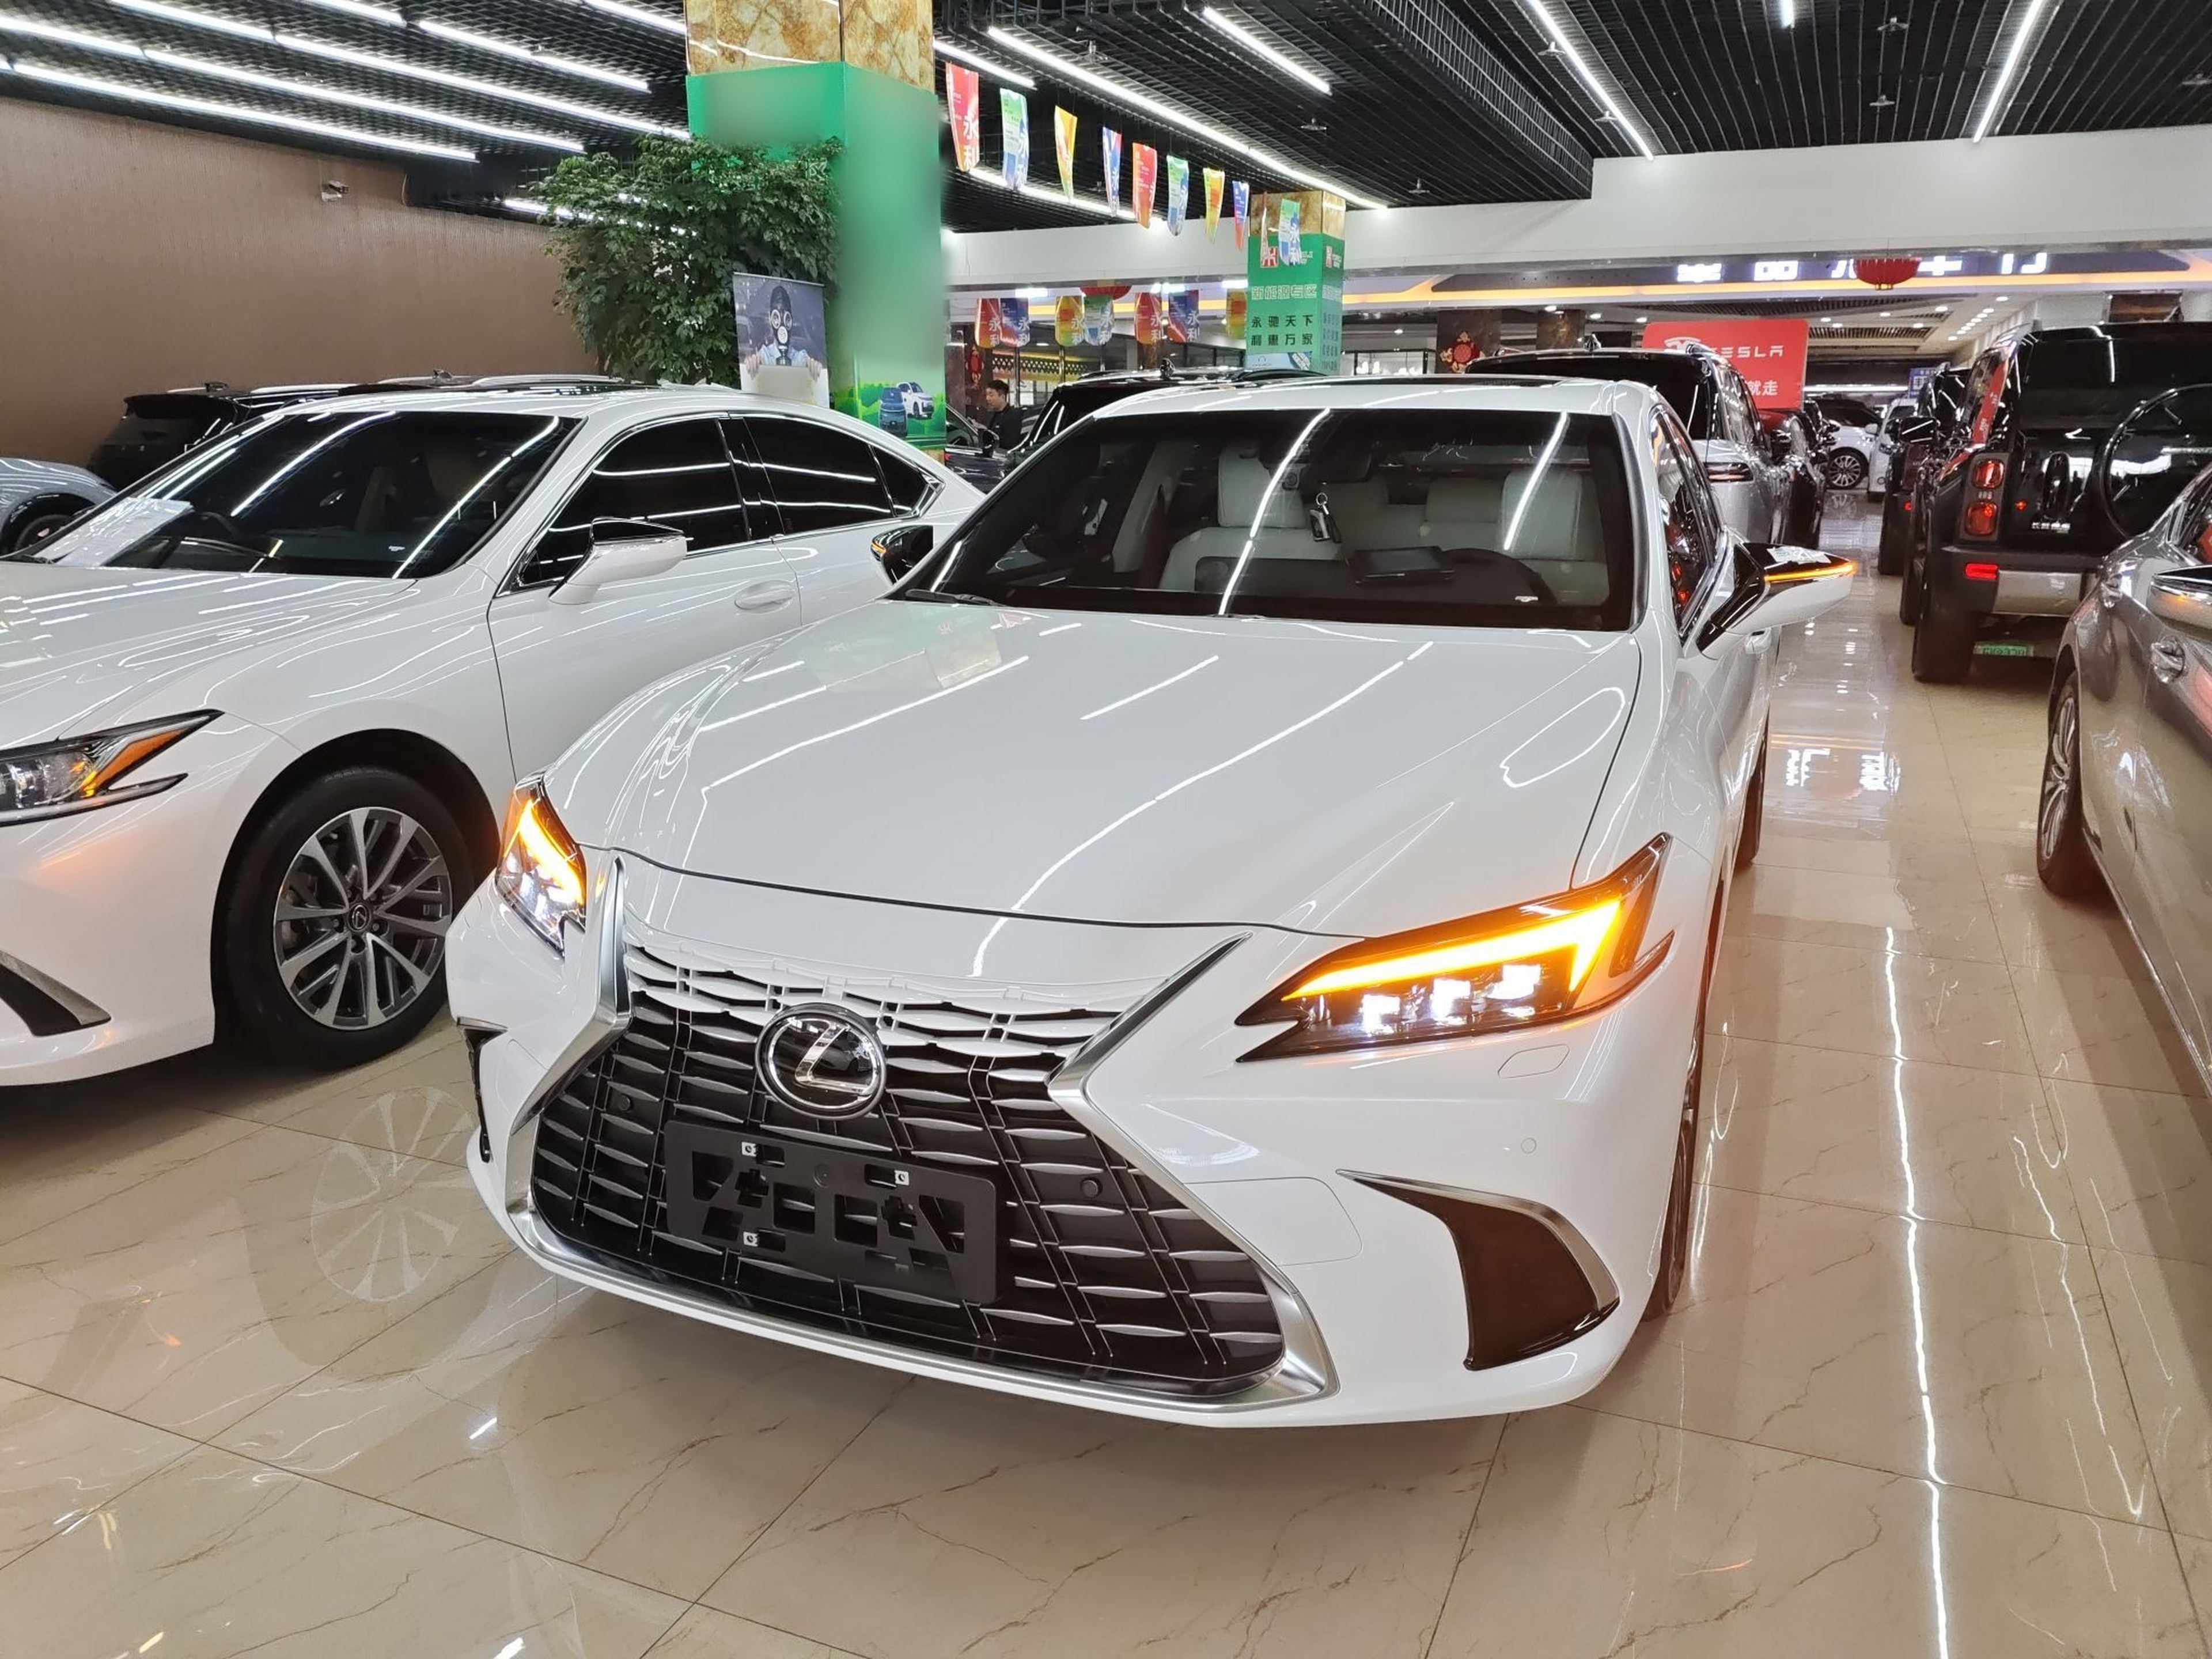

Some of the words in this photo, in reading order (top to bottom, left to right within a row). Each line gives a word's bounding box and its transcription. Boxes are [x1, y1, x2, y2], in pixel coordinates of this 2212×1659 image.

[1251, 284, 1317, 300] 新能源专区
[1251, 315, 1313, 328] 永驰天下
[1251, 334, 1313, 346] 利惠万家
[1713, 345, 1783, 358] ESLA
